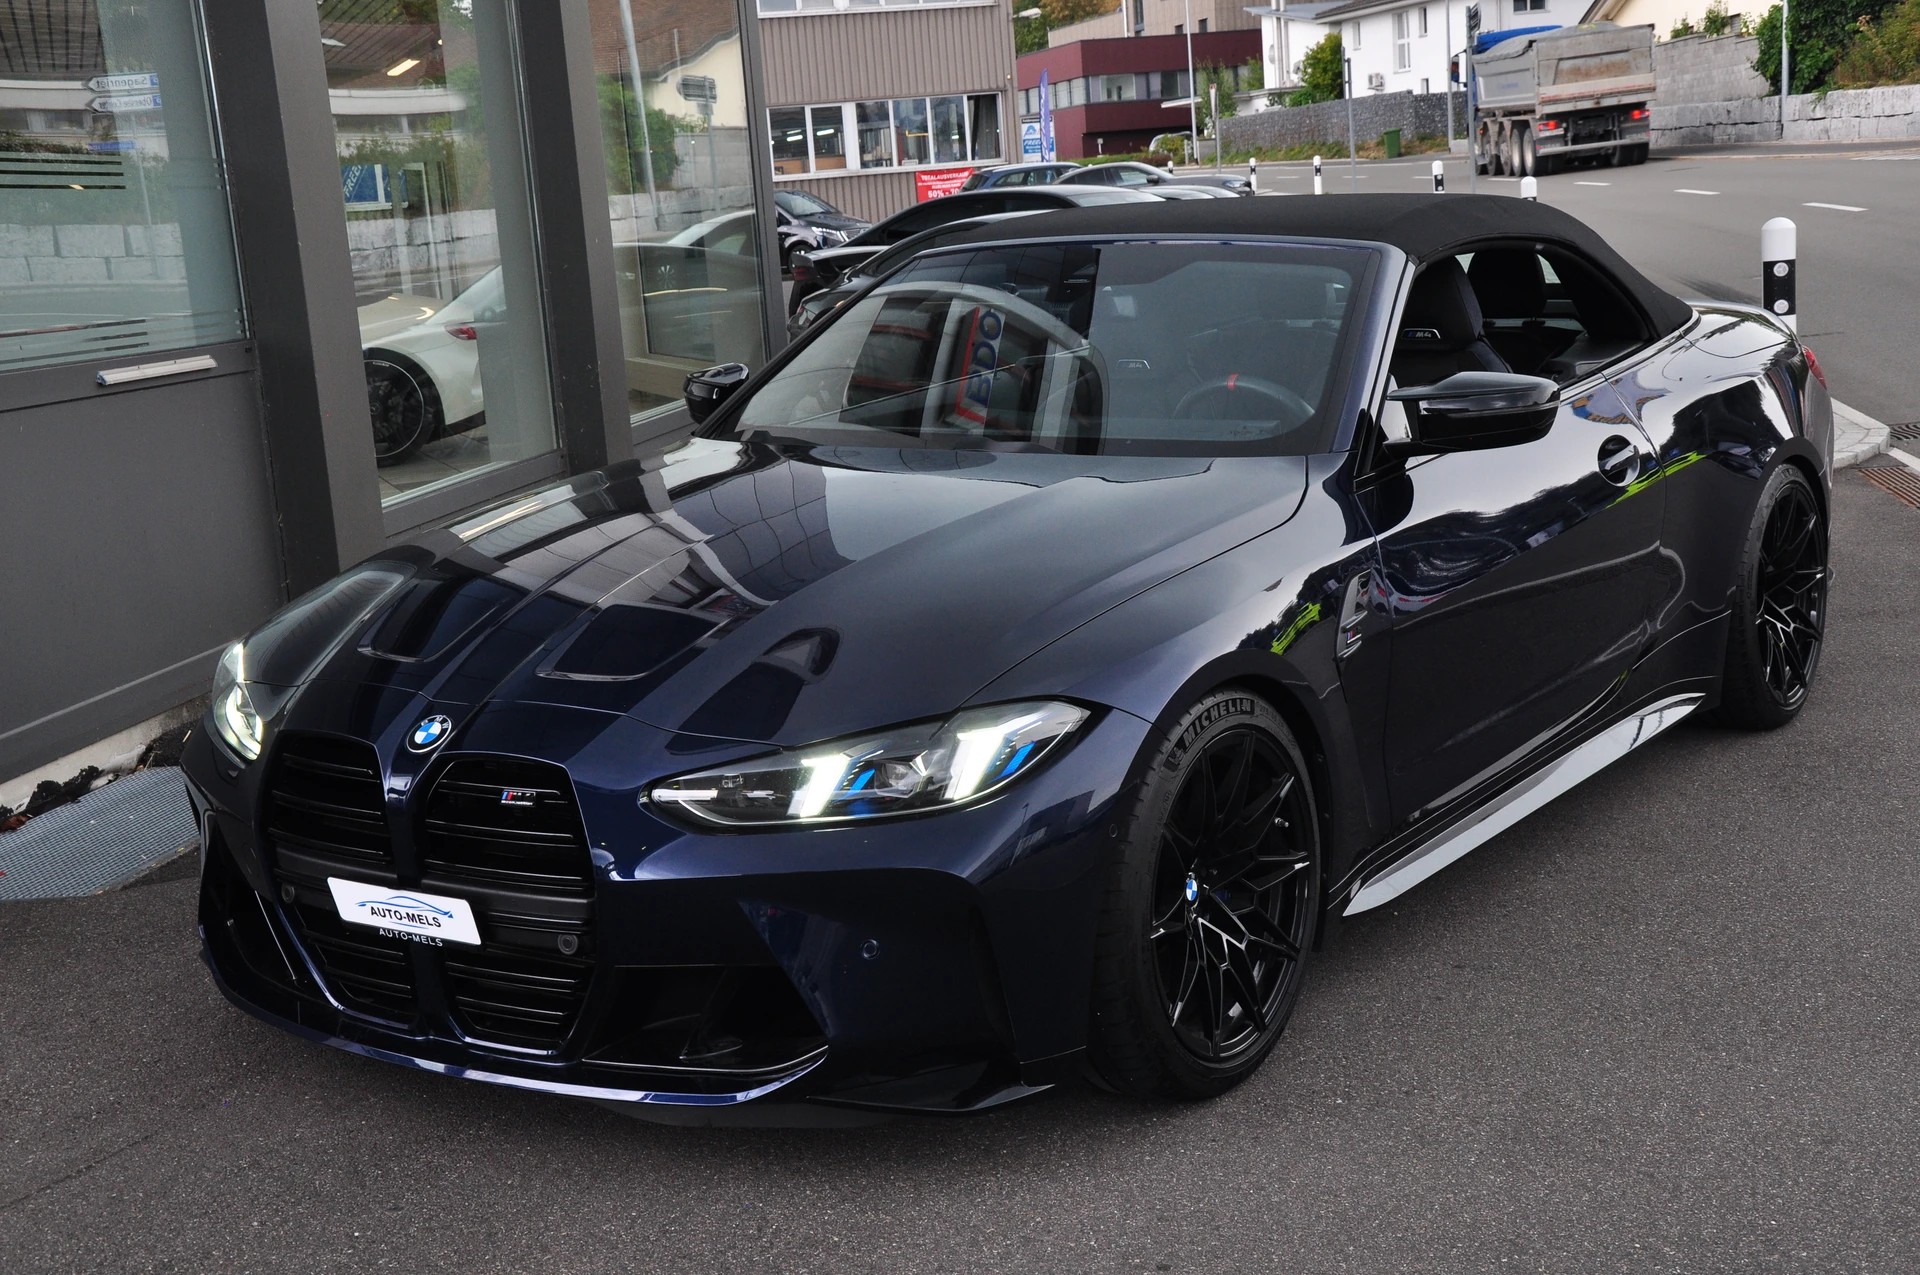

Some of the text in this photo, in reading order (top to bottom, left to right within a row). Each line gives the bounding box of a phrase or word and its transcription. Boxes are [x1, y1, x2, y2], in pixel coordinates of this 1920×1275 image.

[1182, 699, 1252, 747] MICHELIN
[370, 905, 442, 928] AUTO-MELS
[379, 927, 443, 947] AUTO-MELS
